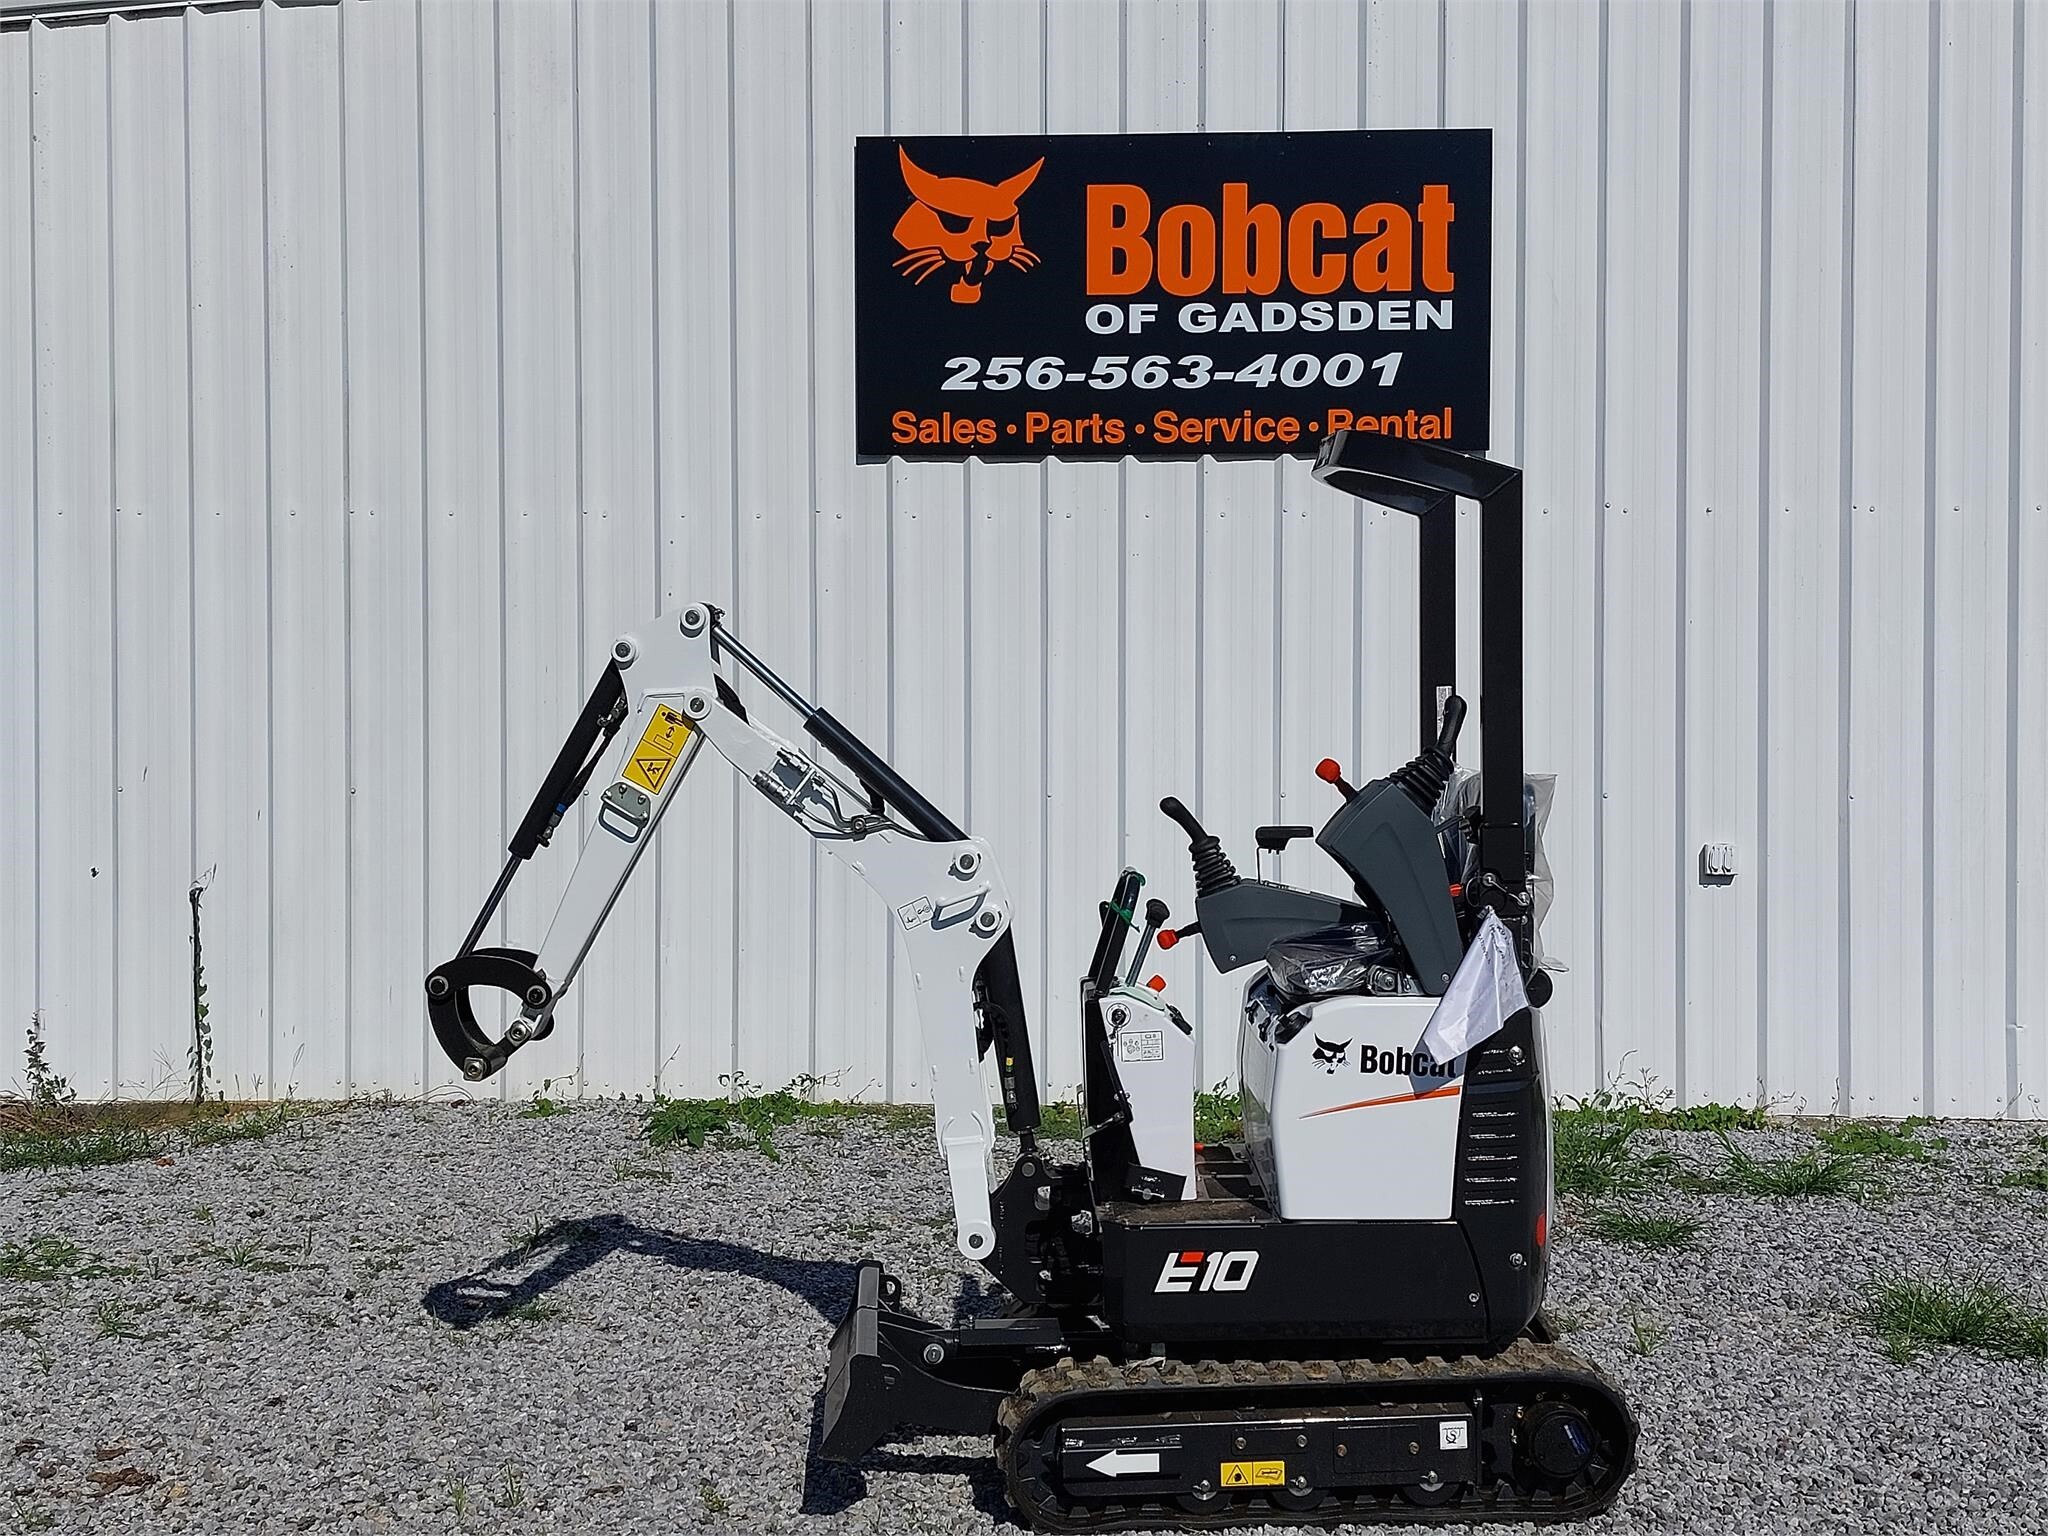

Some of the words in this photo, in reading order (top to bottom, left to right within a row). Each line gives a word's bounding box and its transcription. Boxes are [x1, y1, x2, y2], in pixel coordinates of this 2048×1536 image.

[1086, 182, 1455, 297] Bobcat
[1085, 303, 1159, 335] OF
[1178, 299, 1454, 334] GADSDEN
[940, 351, 1404, 391] 256-563-4001
[891, 410, 997, 444] Sales
[1026, 411, 1126, 444] Parts
[1153, 409, 1301, 444] Service
[1154, 1250, 1260, 1293] E10
